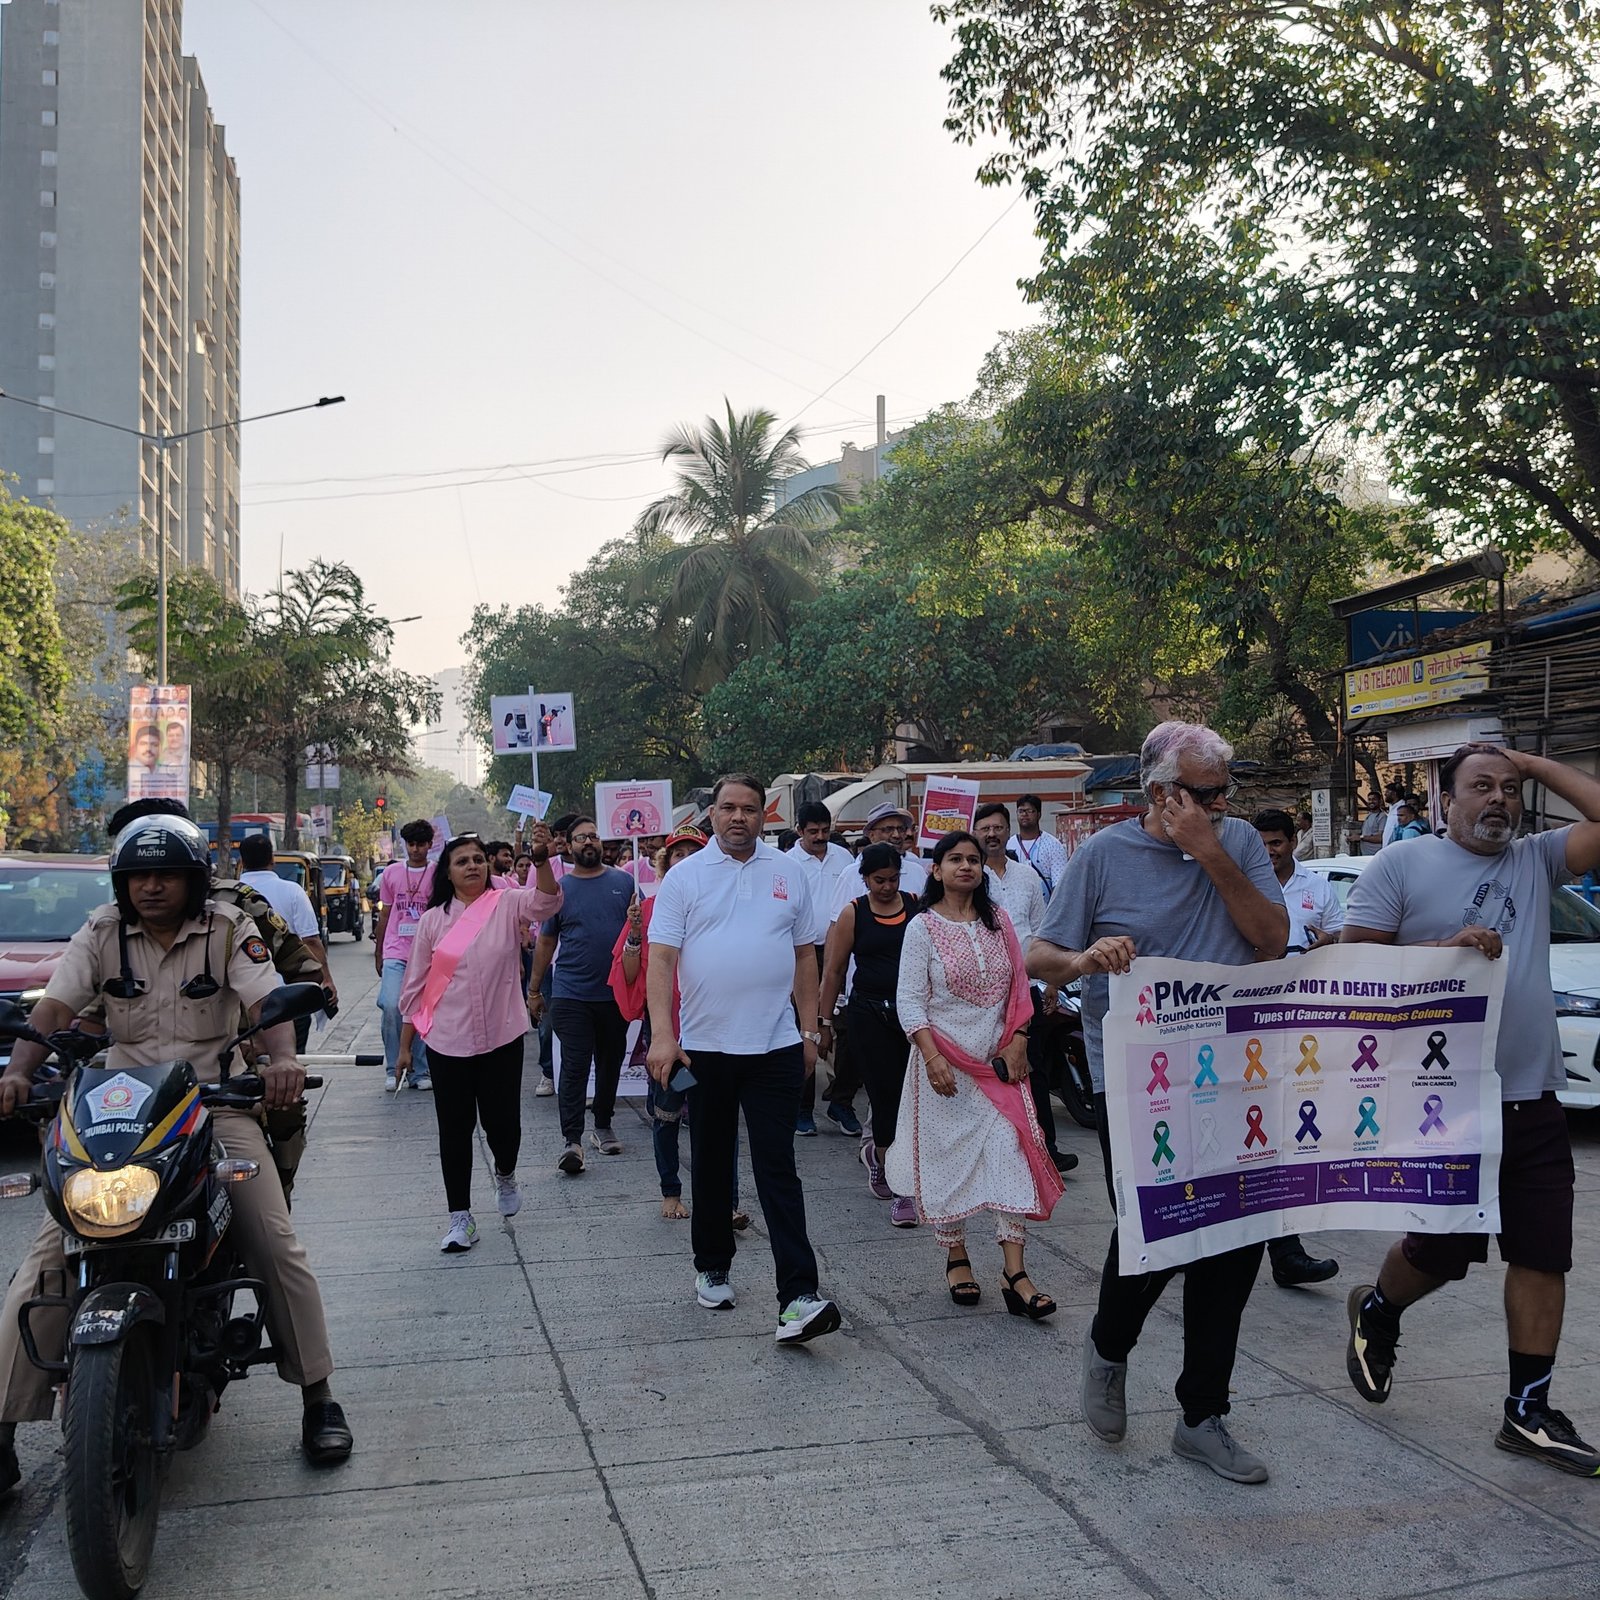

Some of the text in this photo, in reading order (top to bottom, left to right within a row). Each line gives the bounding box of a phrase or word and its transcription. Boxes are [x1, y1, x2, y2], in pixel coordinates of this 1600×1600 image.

[1371, 664, 1411, 689] TELECOM
[1475, 885, 1488, 905] RUN
[1154, 980, 1230, 1010] PMK
[1232, 985, 1283, 998] CANCER
[1299, 979, 1327, 994] NOT
[1330, 980, 1340, 995] A
[1343, 982, 1387, 997] DEATH
[1156, 1005, 1224, 1025] Foundation
[1253, 1008, 1453, 1024] Types of Cancer & Awareness Colours
[1195, 1020, 1222, 1030] Kartavya
[1150, 1098, 1169, 1107] BREAST
[1149, 1106, 1171, 1114] CANCER
[85, 1123, 144, 1138] MUMBAI POLICE
[1236, 1153, 1254, 1161] BLOOD
[1254, 1148, 1278, 1158] CANCERS
[1158, 1168, 1171, 1176] LIVER
[1329, 1162, 1350, 1170] Know
[1366, 1160, 1400, 1168] Colours,
[1155, 1174, 1175, 1183] CANCER
